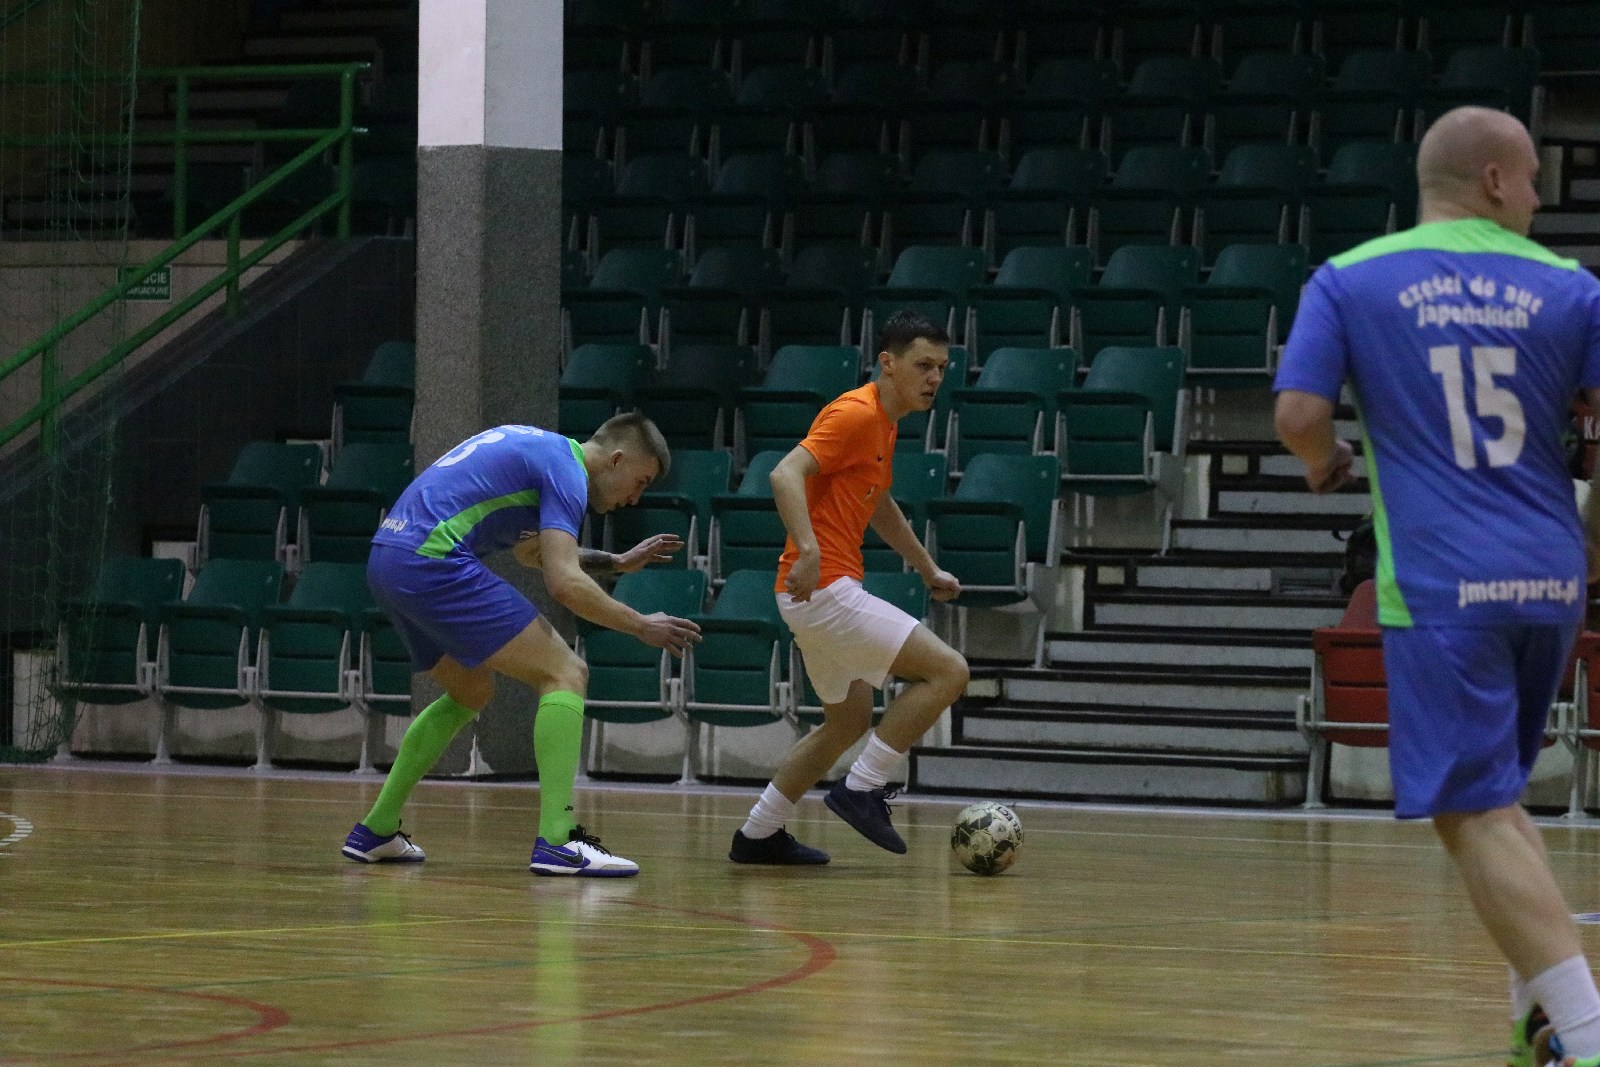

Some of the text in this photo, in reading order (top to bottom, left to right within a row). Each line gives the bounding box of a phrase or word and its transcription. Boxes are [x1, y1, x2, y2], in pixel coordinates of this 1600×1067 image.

[1469, 274, 1497, 298] do
[1504, 284, 1543, 315] aut
[1428, 344, 1527, 470] 15
[1458, 576, 1579, 608] jmcarparts.pl
